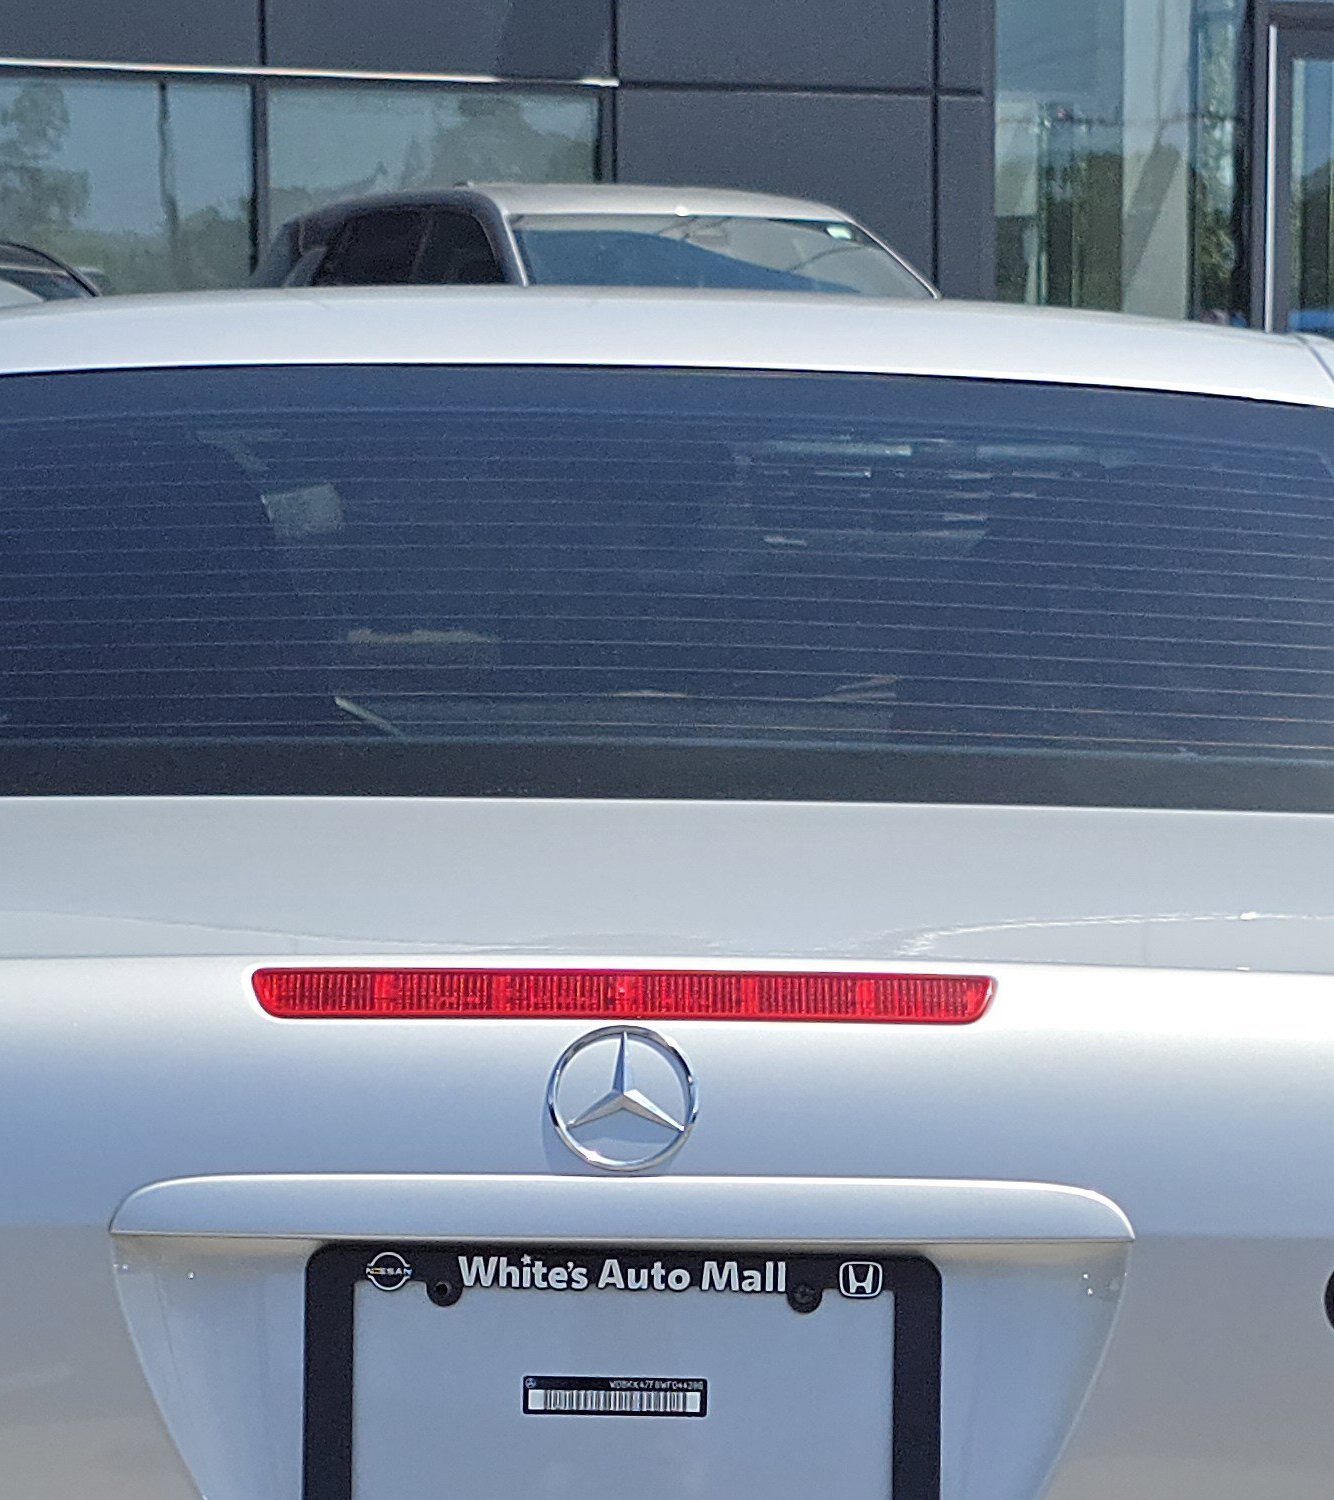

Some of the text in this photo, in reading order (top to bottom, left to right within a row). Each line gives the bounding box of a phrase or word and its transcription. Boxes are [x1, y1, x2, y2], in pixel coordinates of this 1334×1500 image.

[457, 1253, 787, 1294] White's Auto Mall
